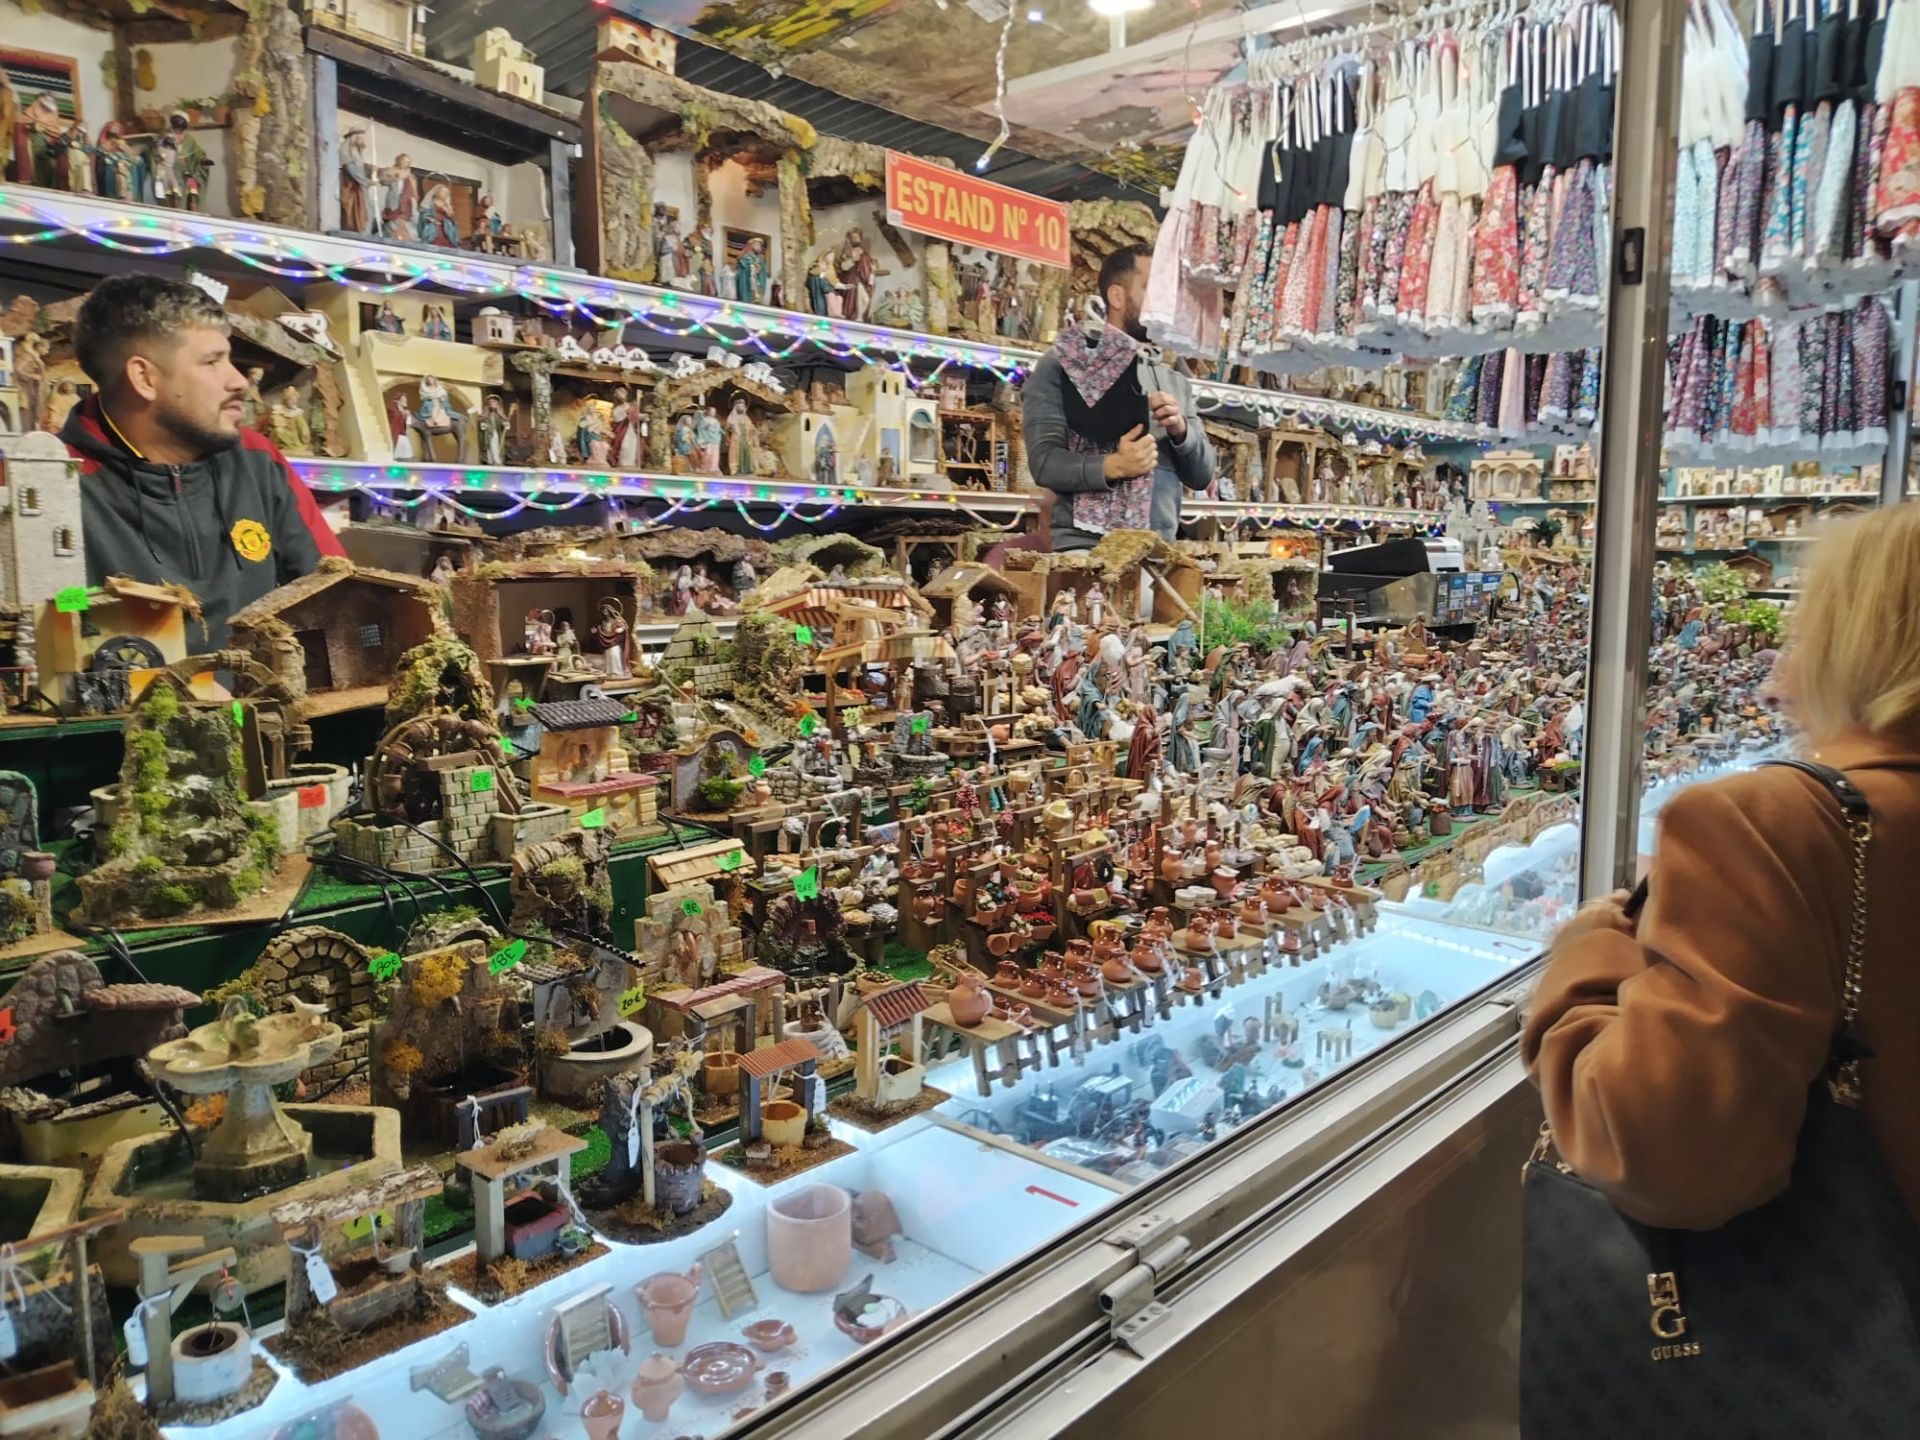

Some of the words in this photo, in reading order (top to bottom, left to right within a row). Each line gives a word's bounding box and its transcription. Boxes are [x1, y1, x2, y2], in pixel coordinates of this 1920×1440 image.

[896, 170, 996, 234] ESTAND
[1034, 212, 1061, 251] 10
[491, 948, 516, 967] 18€
[1651, 1342, 1701, 1361] GUESS
